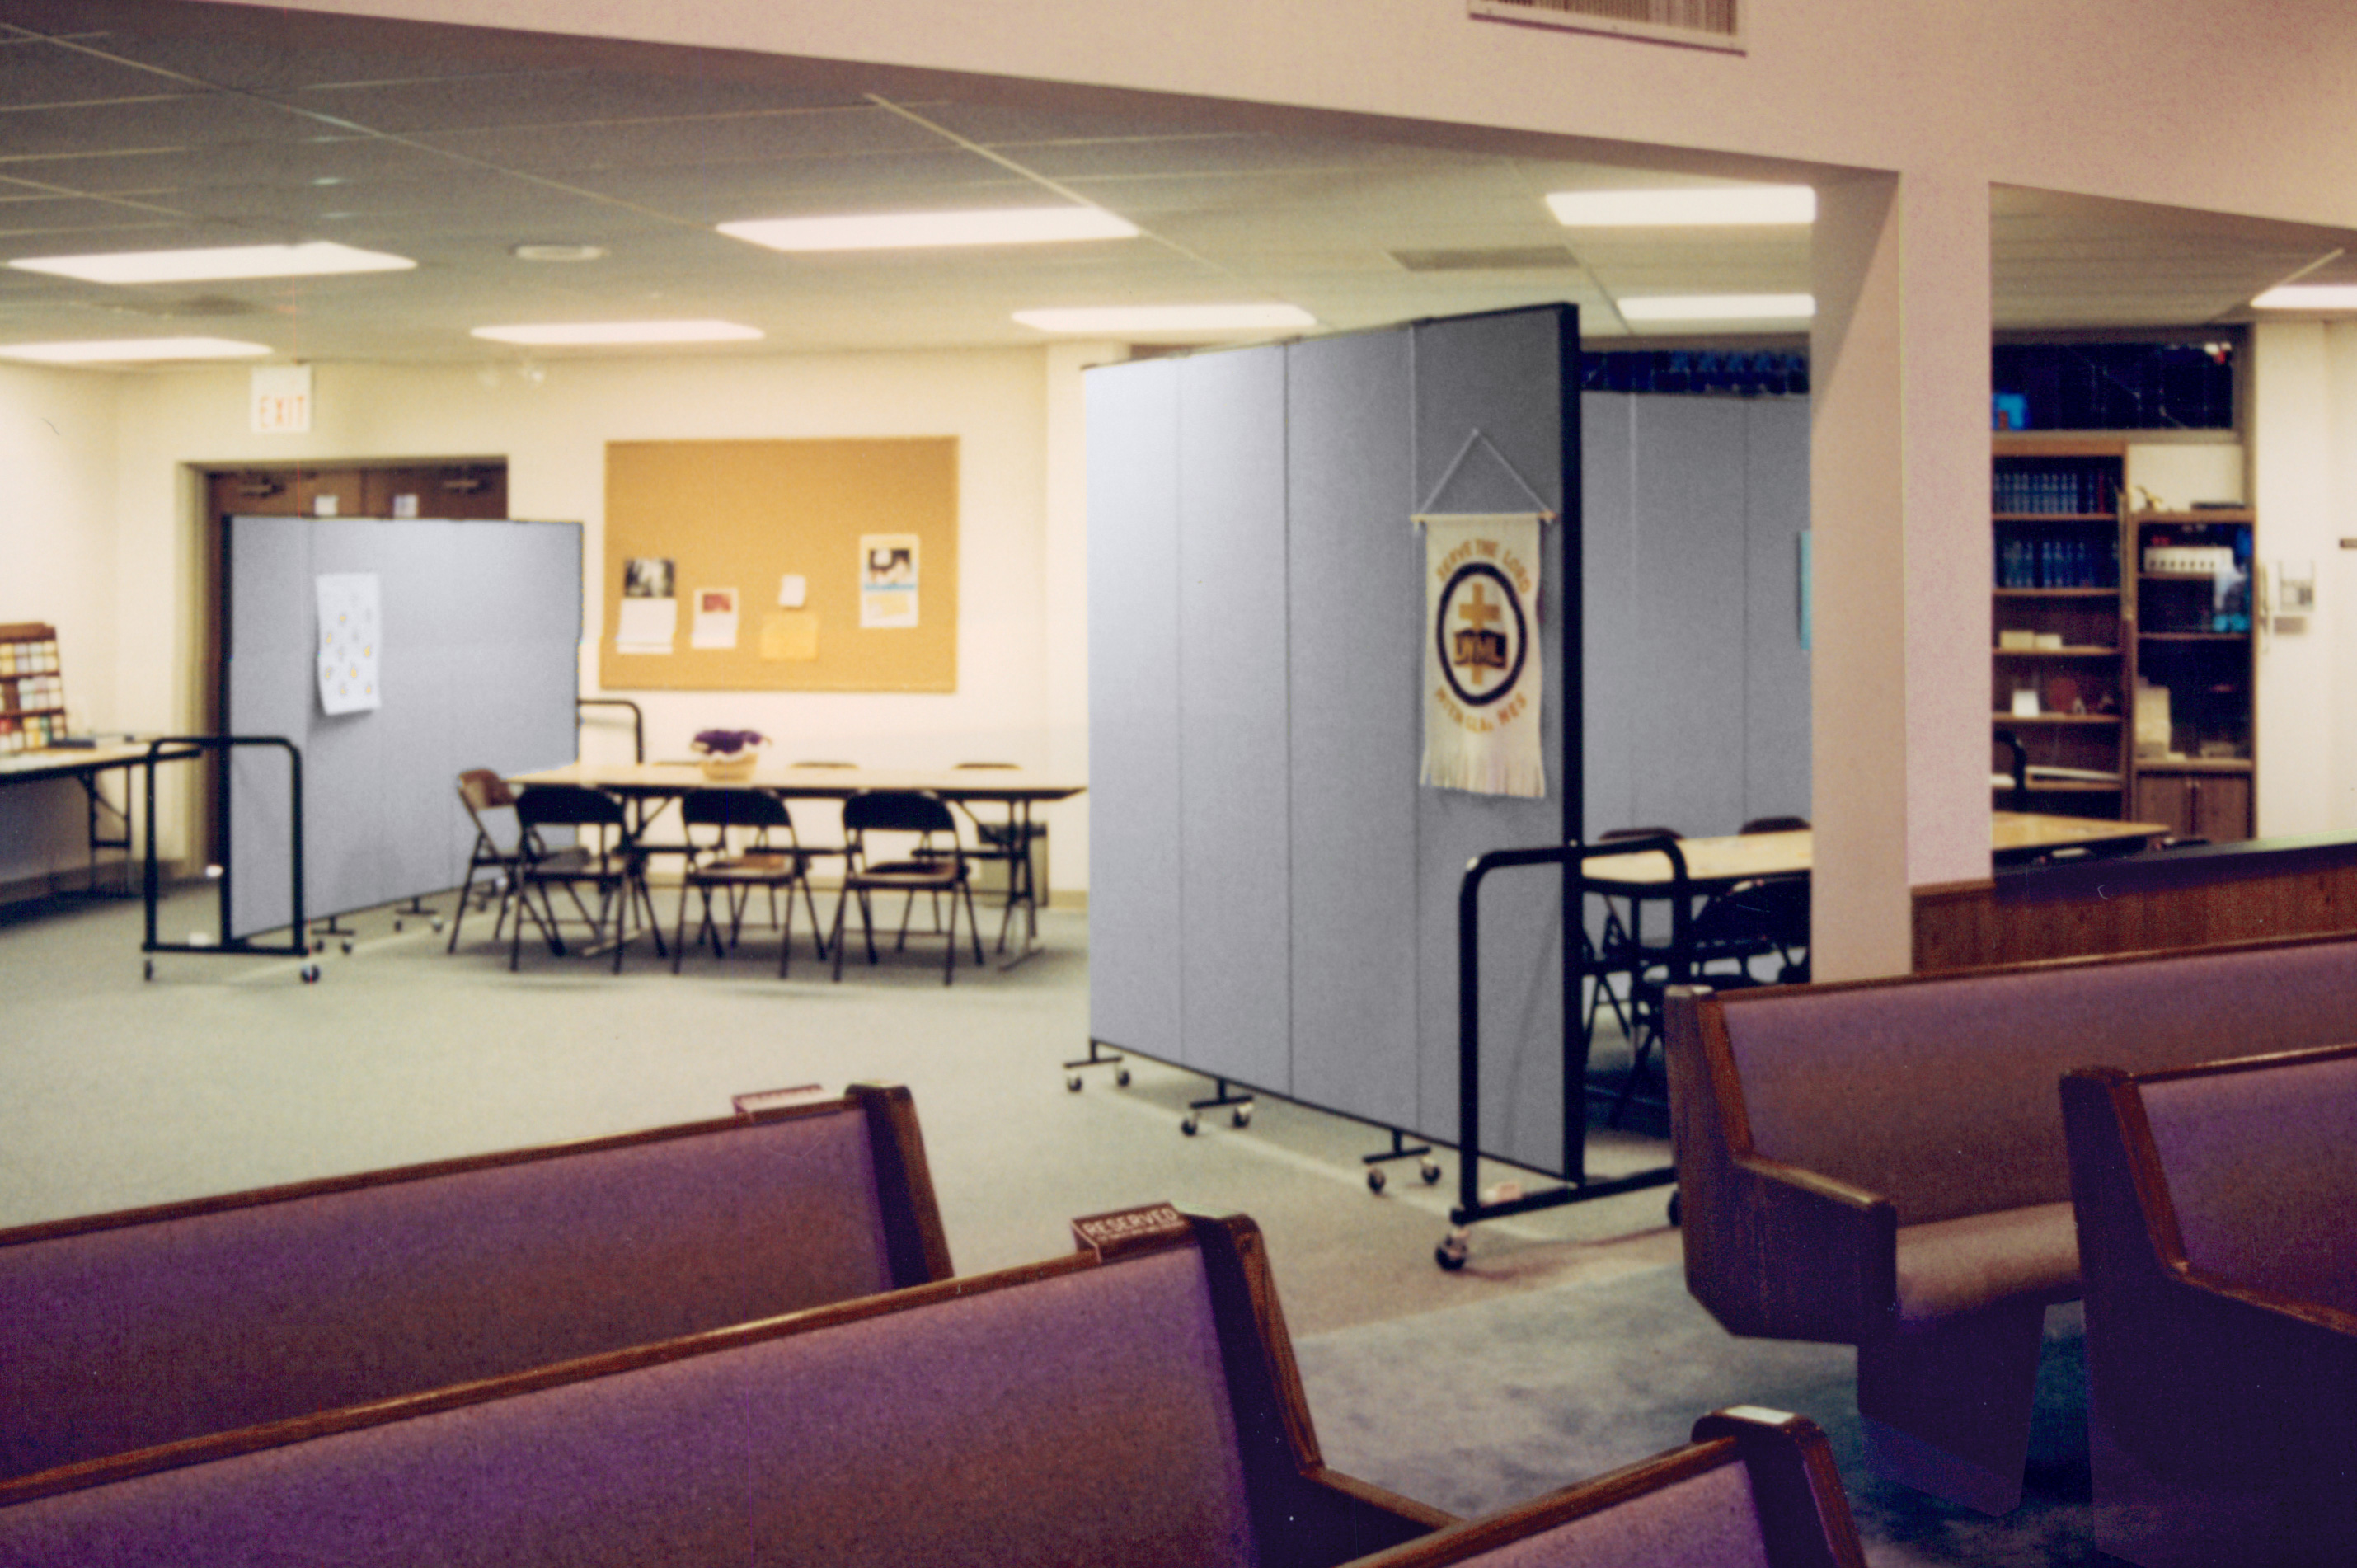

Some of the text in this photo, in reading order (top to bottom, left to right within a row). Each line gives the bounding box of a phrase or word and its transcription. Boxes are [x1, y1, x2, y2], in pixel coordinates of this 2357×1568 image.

[259, 395, 305, 428] EXIT
[1436, 538, 1532, 594] SERVE THE LORD
[1082, 1207, 1178, 1236] RESERVED
